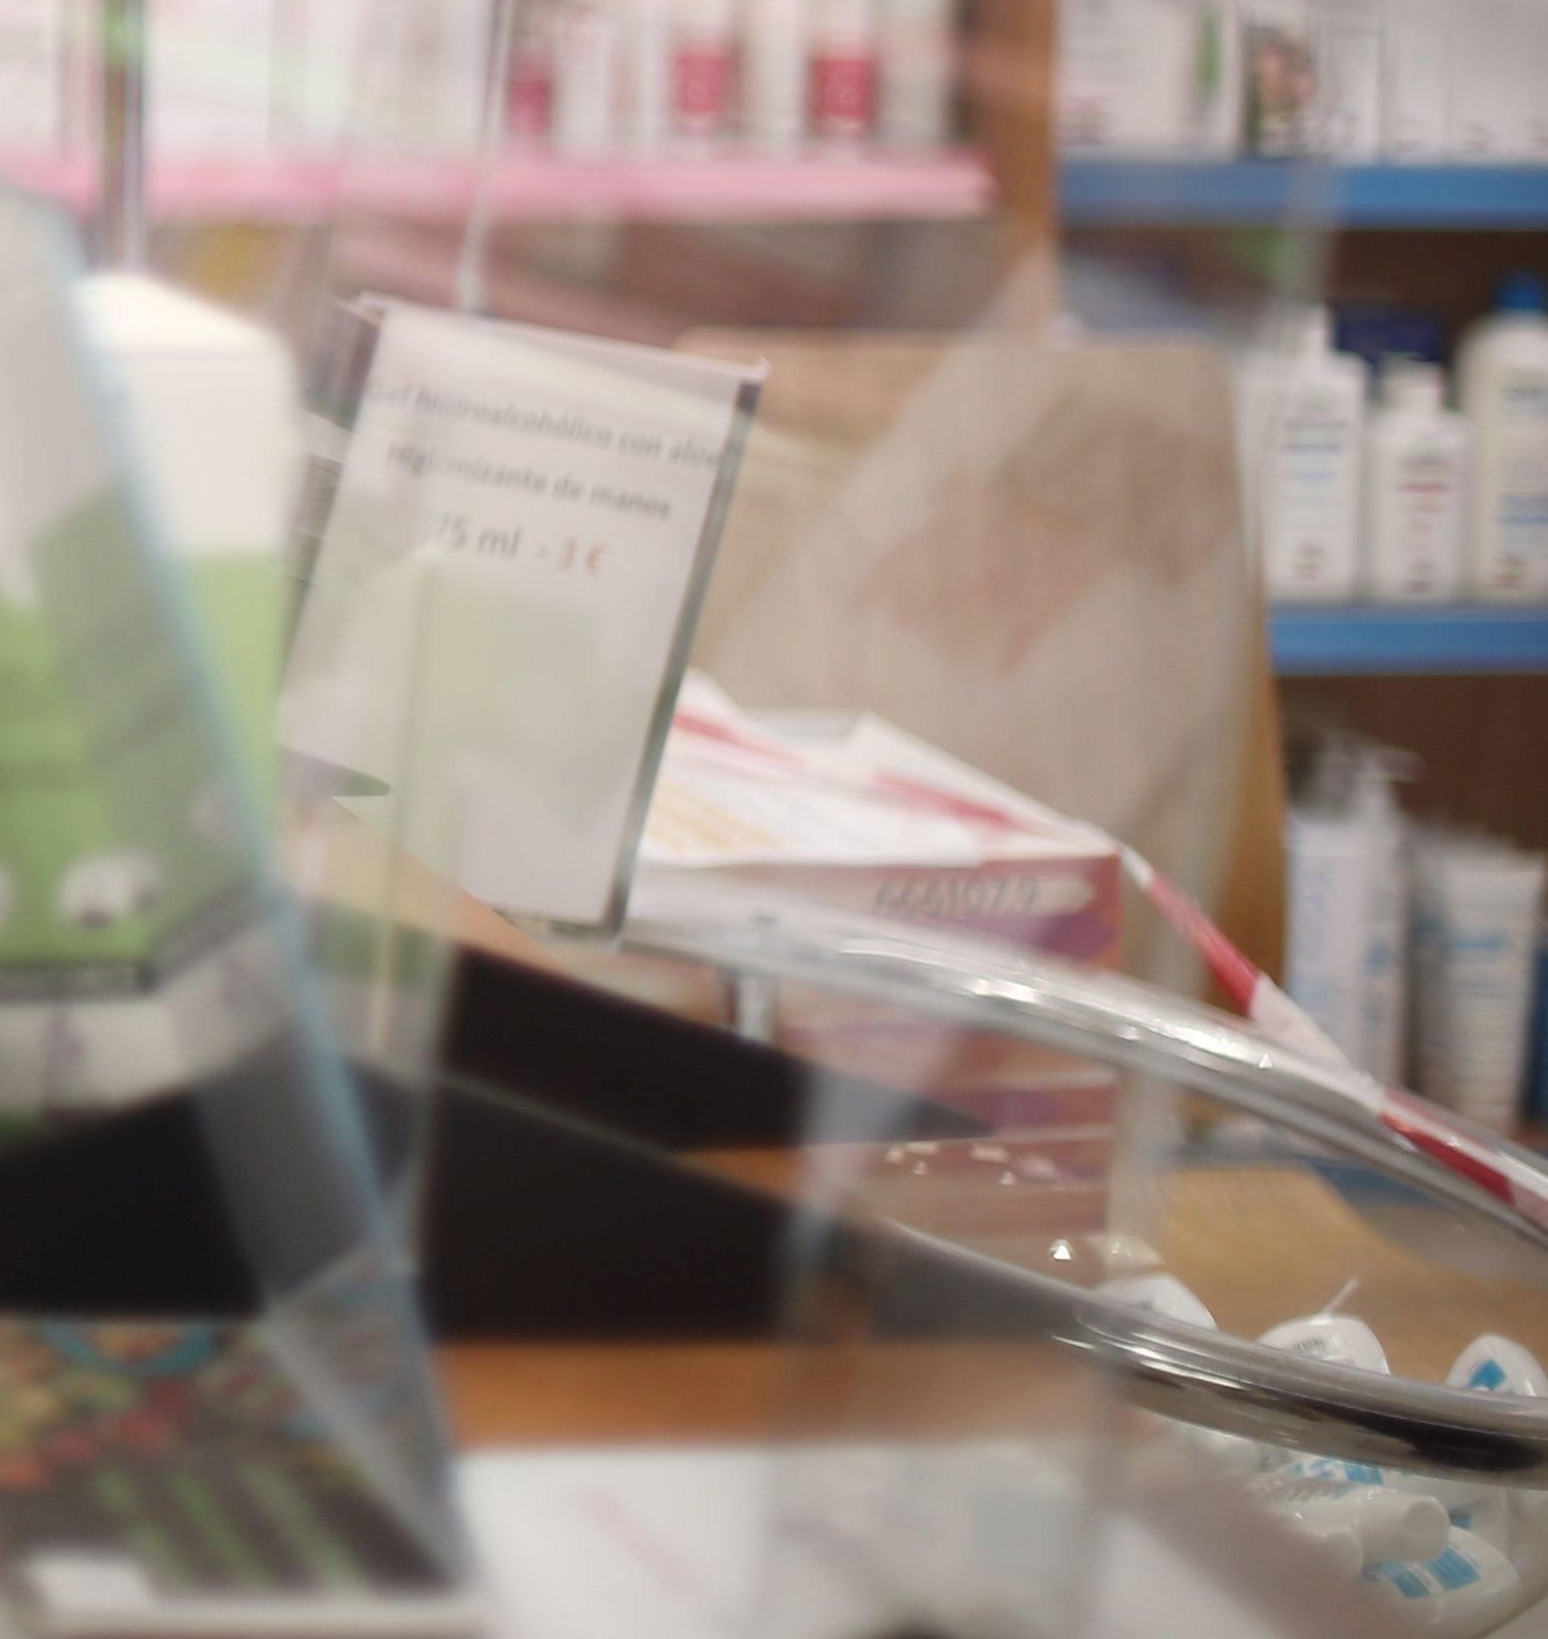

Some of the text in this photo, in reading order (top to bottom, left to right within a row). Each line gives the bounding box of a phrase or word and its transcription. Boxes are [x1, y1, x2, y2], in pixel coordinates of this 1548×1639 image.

[552, 470, 584, 502] de
[589, 489, 672, 522] manos
[476, 522, 524, 559] ml
